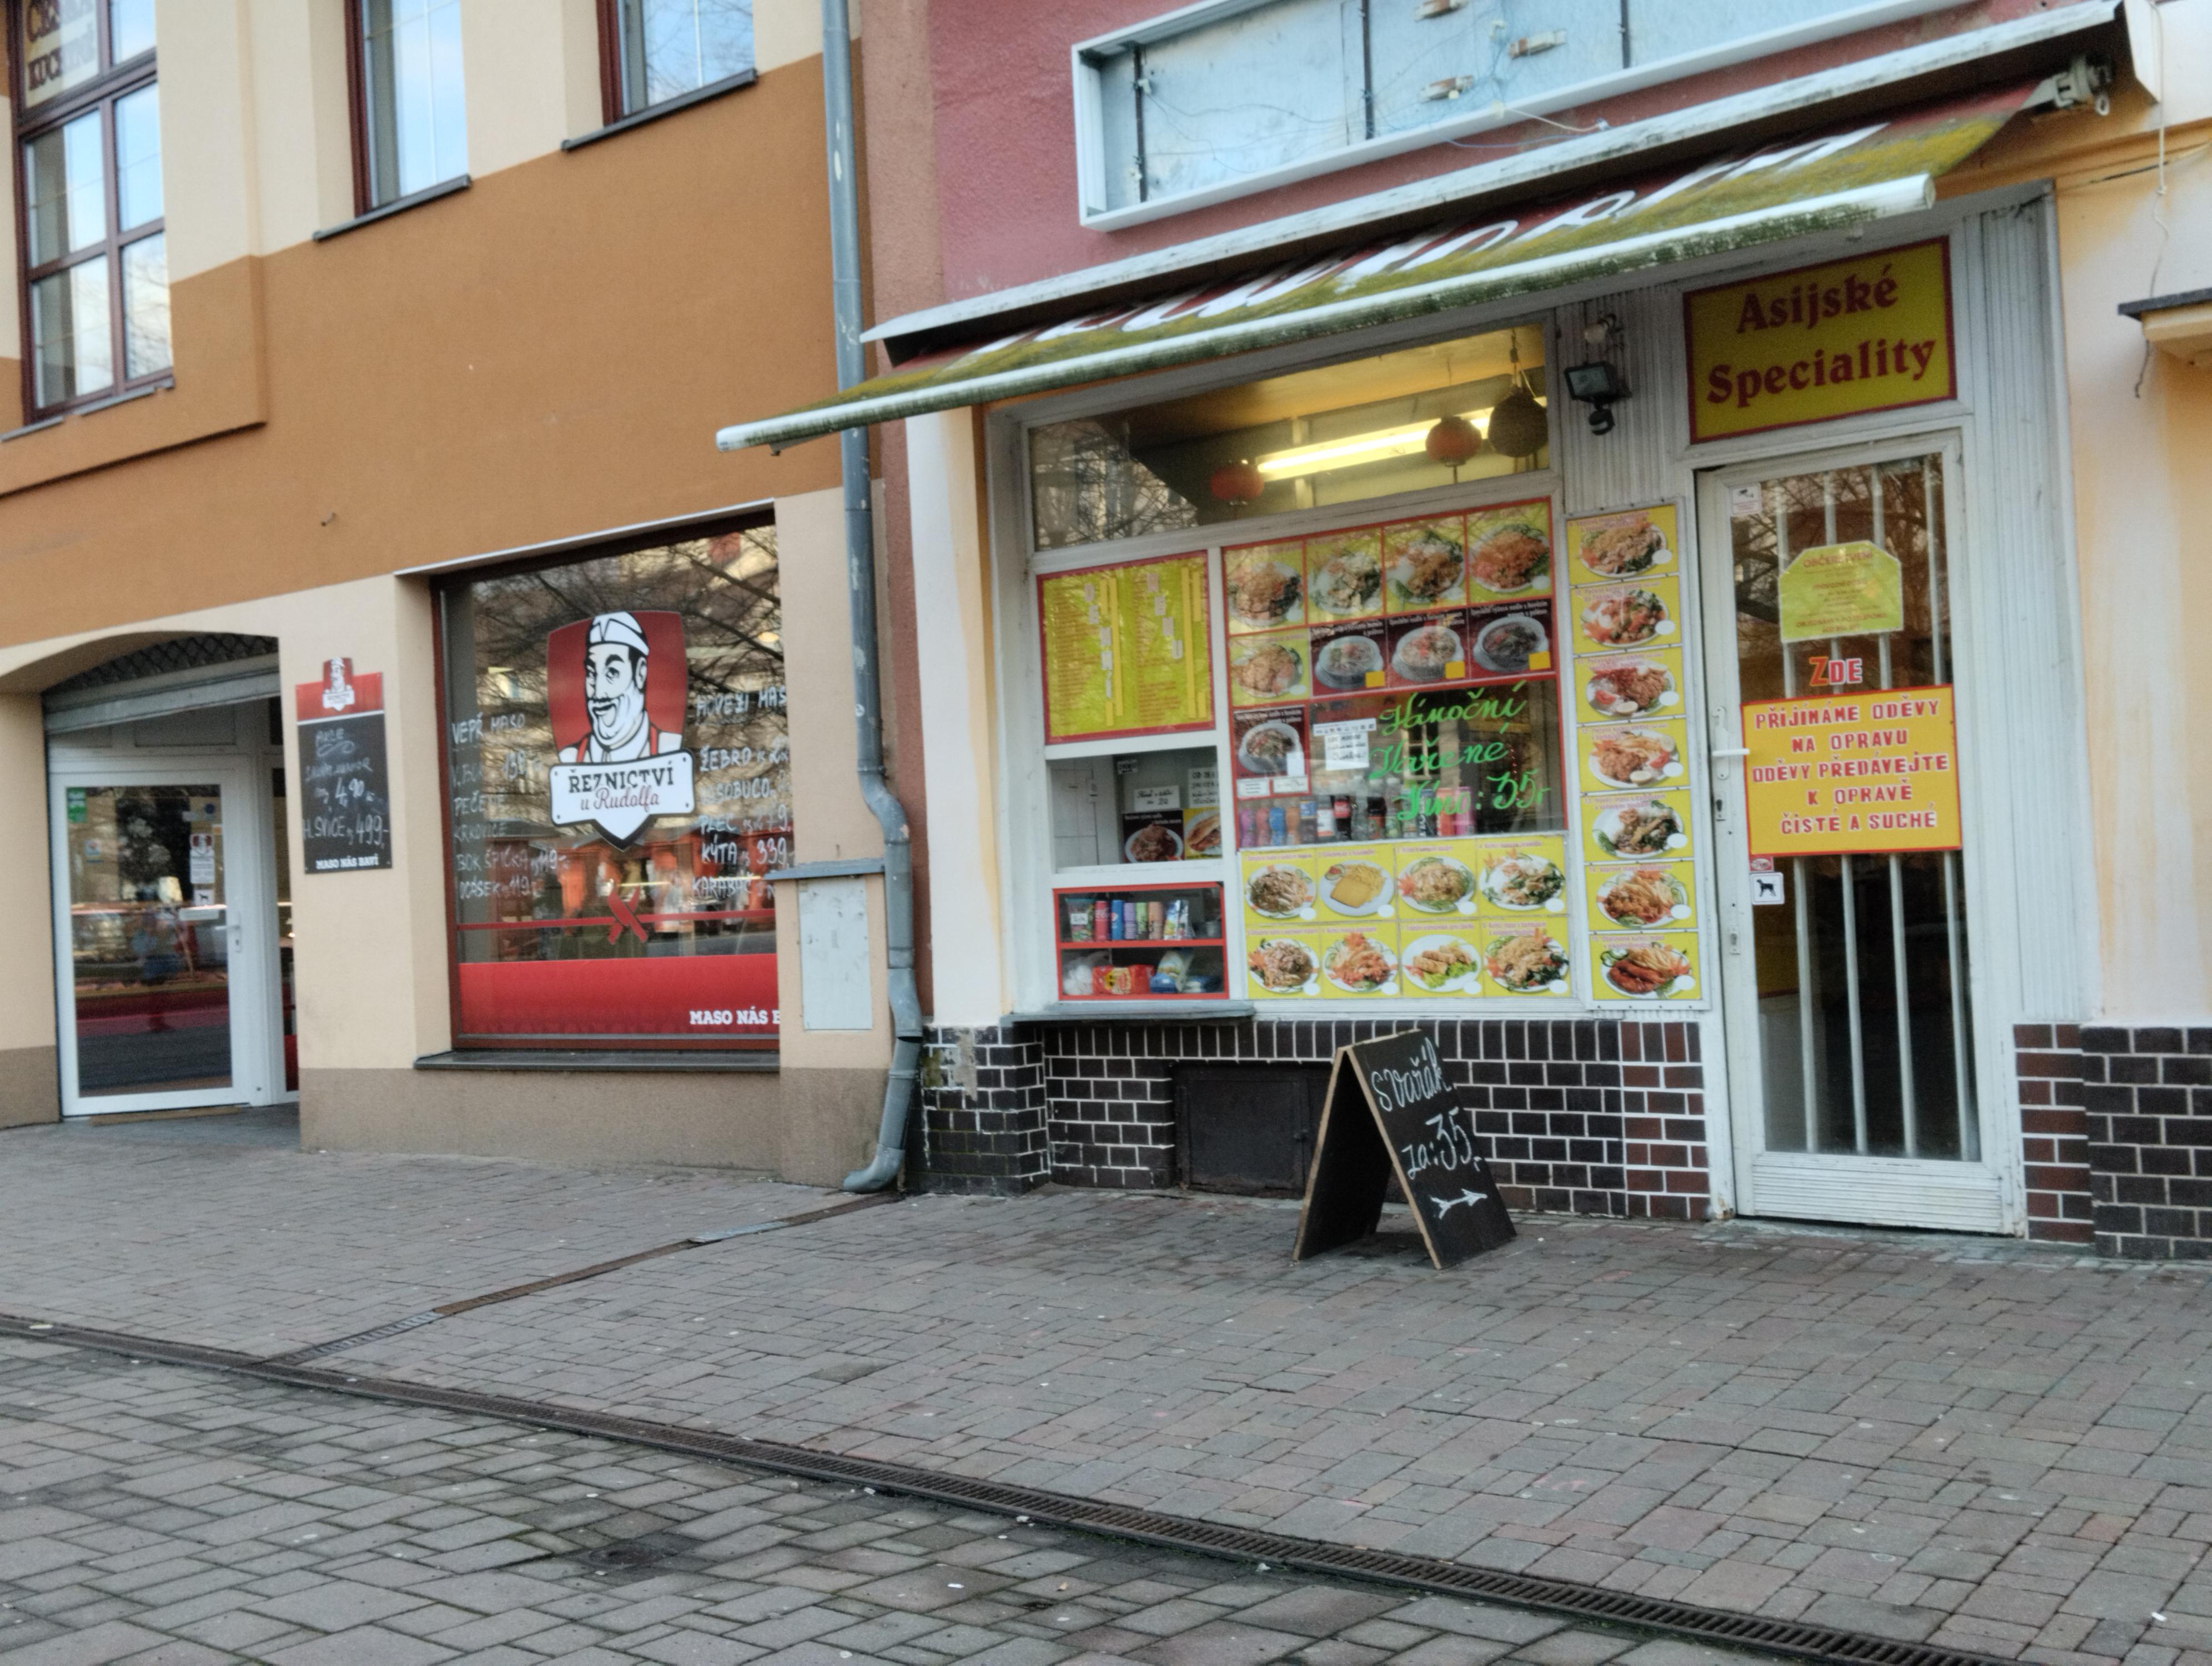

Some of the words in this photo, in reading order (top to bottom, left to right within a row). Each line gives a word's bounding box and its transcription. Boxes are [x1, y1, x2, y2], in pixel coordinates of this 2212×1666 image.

[1736, 263, 1898, 333] Asijské
[1706, 338, 1936, 408] Speciality
[1808, 656, 1862, 686] ZDE
[1379, 680, 1527, 736] Vánoční
[1872, 695, 1940, 720] ODĚVY
[1369, 722, 1509, 780] Vařené
[1791, 736, 1816, 752] NA
[1830, 729, 1908, 750] OPRAVU
[569, 760, 673, 793] ŘEZNICTVÍ
[1752, 759, 1811, 782] ODĚVY
[1818, 750, 1949, 778] PŘEDÁVEJTE
[581, 799, 589, 810] u
[594, 785, 659, 812] Rudolfa
[1807, 790, 1819, 806] K
[1834, 778, 1912, 804] OPRAVĚ
[1849, 814, 1860, 831] A
[1869, 802, 1937, 830] SUCHÉ
[701, 834, 737, 865] KÝTA
[689, 1010, 733, 1025] MASO
[736, 1006, 769, 1025] NÁS
